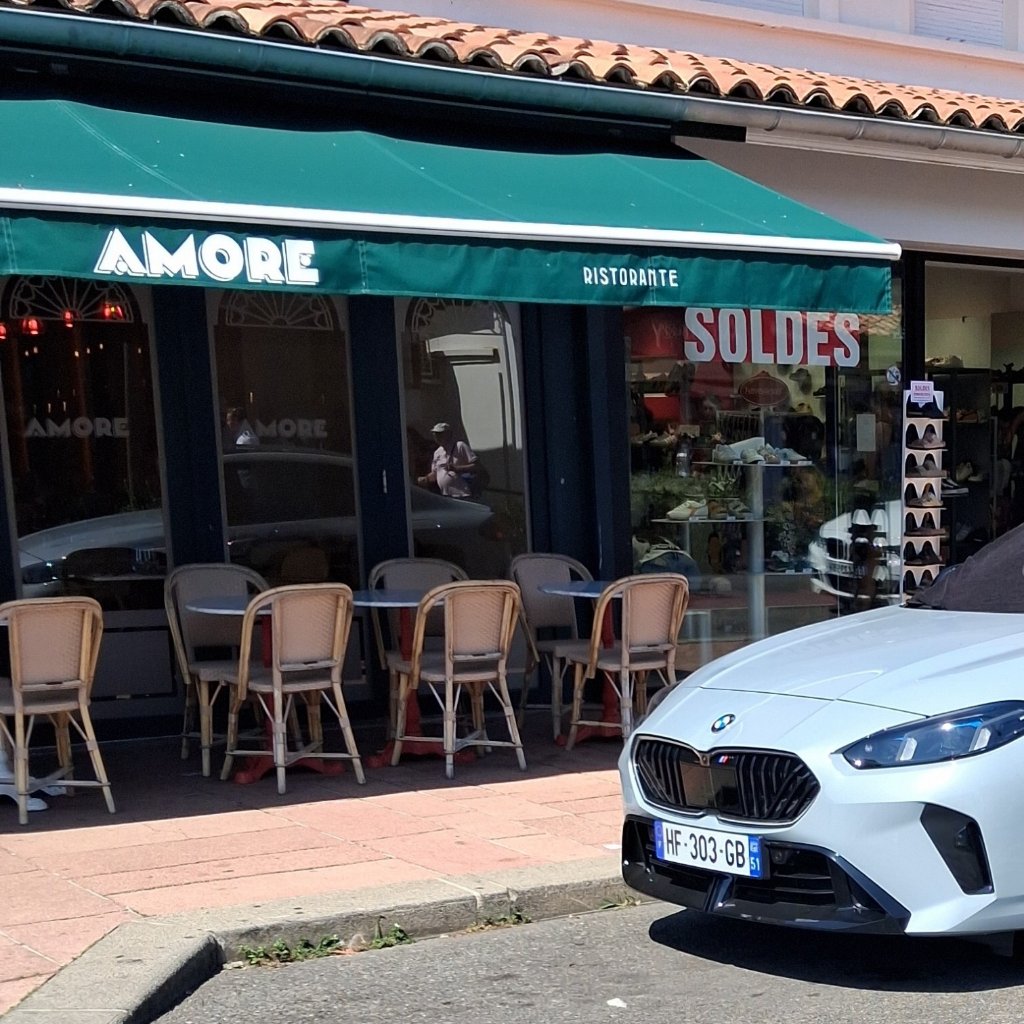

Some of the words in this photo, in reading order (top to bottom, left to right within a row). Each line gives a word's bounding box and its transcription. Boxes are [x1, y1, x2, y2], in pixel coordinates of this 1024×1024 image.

[93, 227, 320, 286] AMORE
[583, 266, 679, 288] RISTORANTE
[683, 306, 861, 368] SOLDES
[25, 417, 130, 438] AMORE
[665, 827, 747, 869] HF-303-GB
[750, 857, 761, 872] 51
